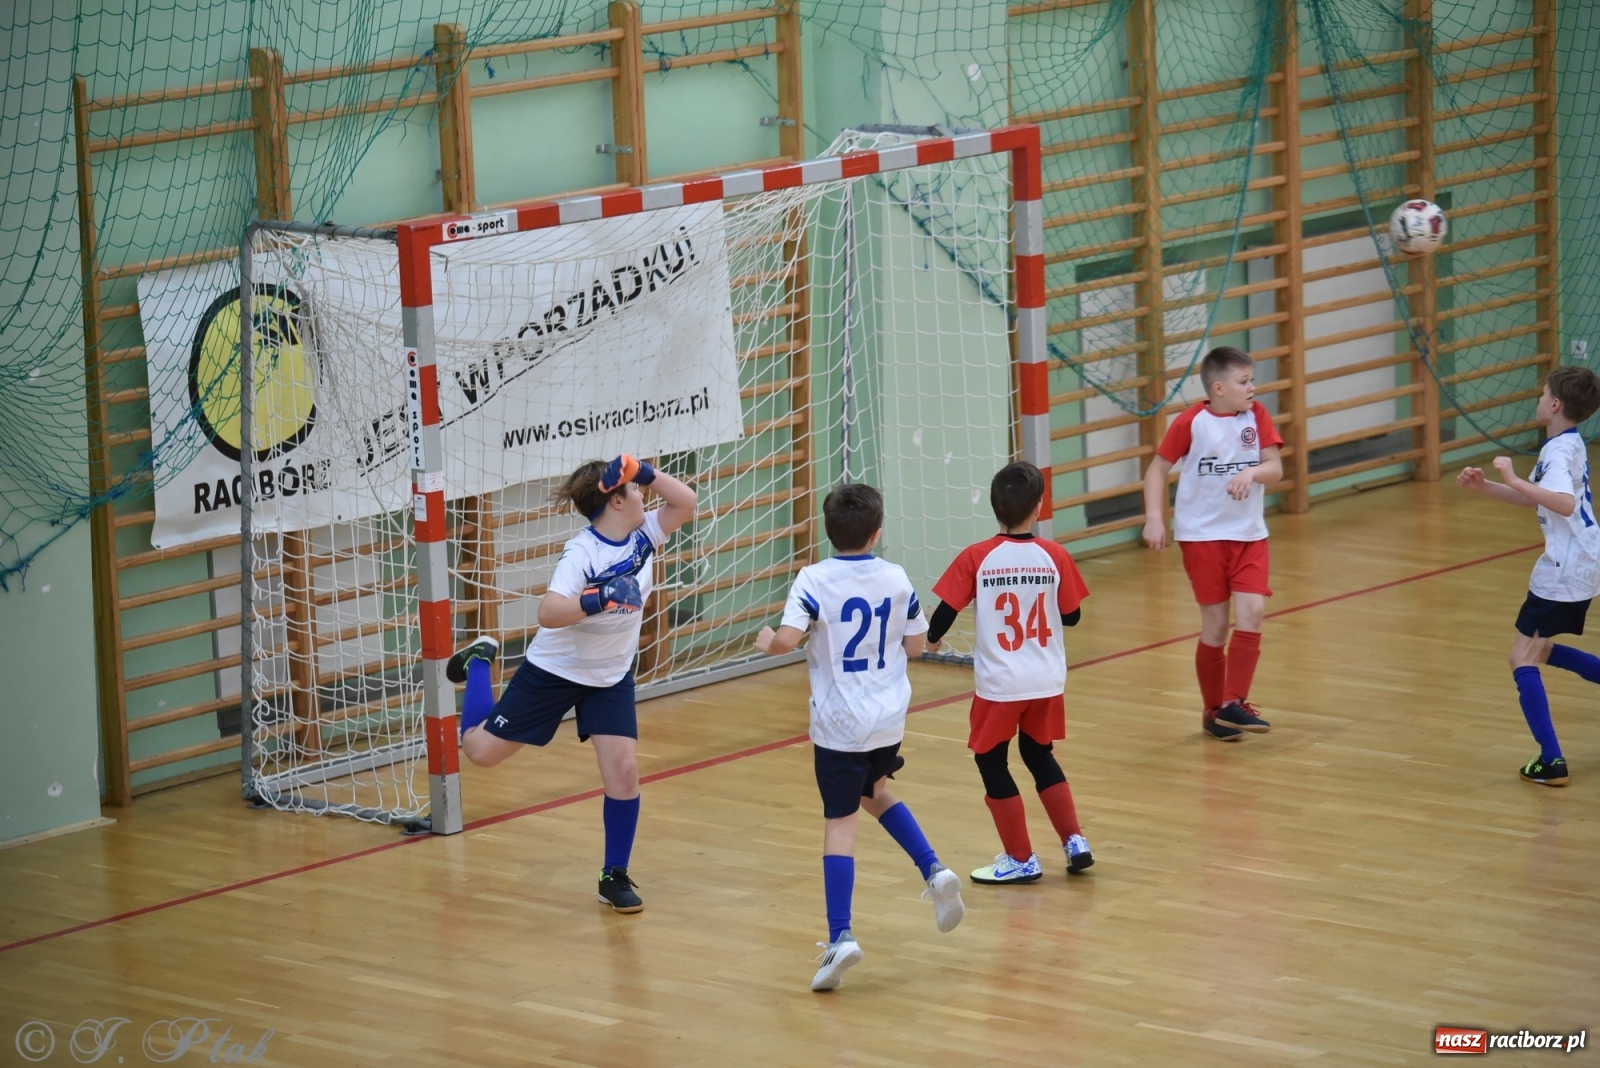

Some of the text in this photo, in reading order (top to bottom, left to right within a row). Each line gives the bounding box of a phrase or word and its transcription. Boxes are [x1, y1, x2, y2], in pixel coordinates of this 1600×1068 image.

[412, 411, 420, 467] sport
[982, 568, 1018, 576] AKADEMIA
[983, 576, 1018, 587] RYMER
[841, 597, 891, 672] 21
[994, 591, 1053, 652] 34
